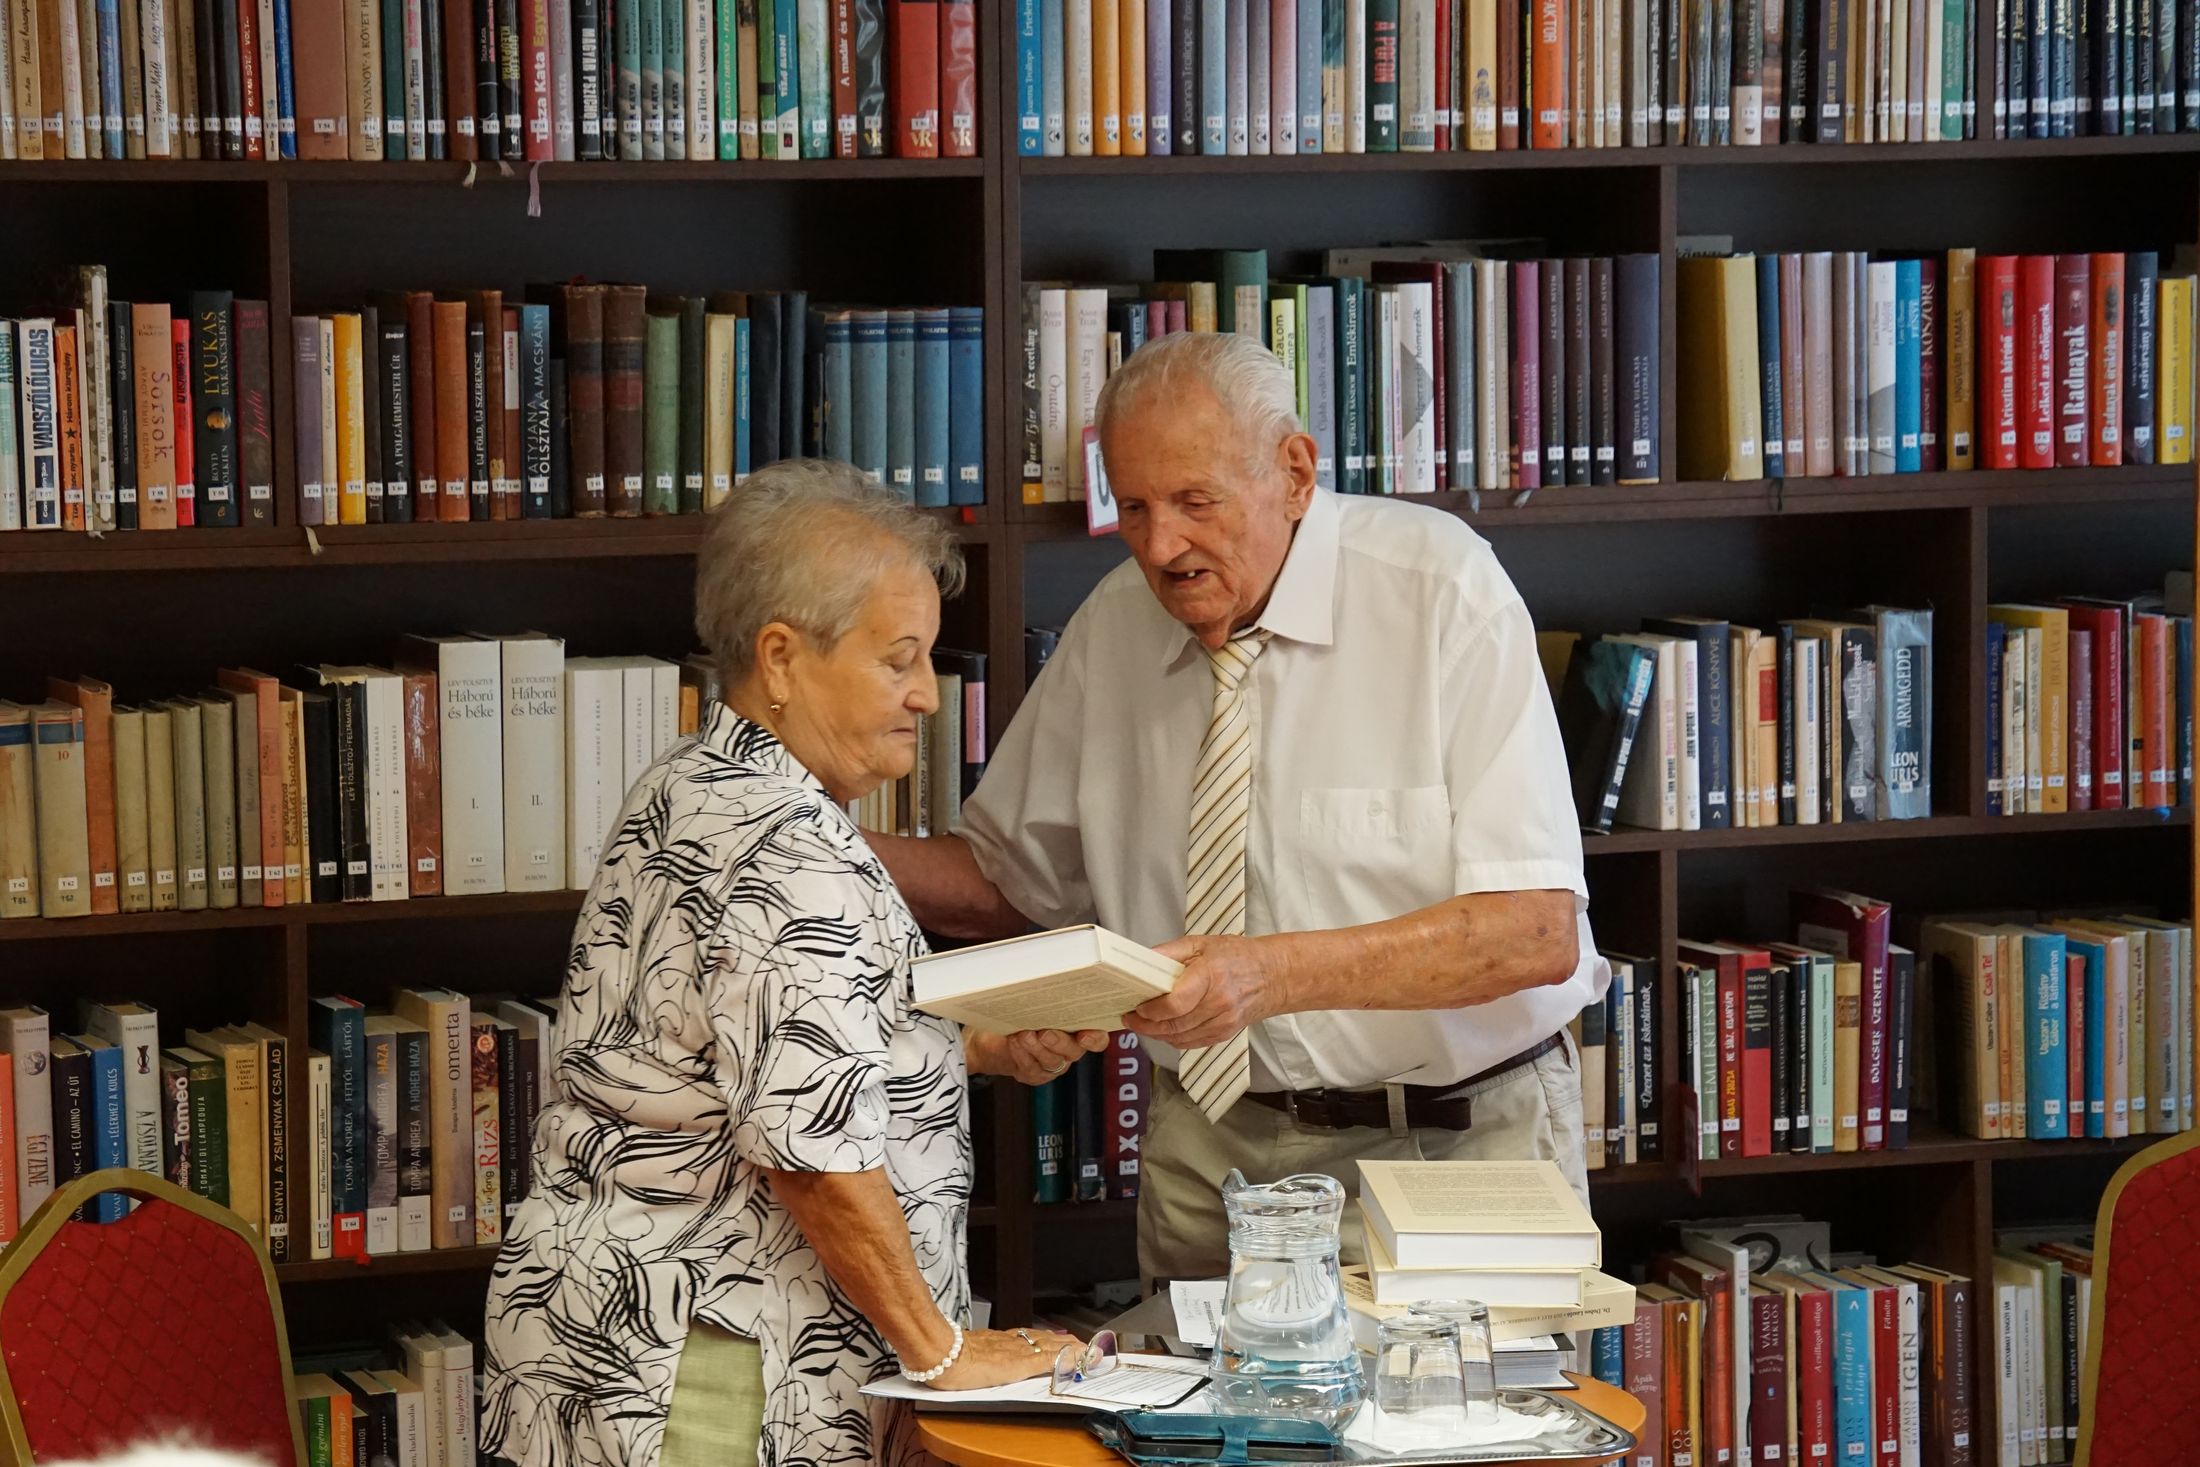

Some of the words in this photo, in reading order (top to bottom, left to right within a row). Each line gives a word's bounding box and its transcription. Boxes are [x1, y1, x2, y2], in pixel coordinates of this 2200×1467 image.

[839, 18, 849, 34] és
[1375, 20, 1395, 30] A
[582, 28, 597, 72] MAGYAR
[839, 43, 850, 73] madár
[1375, 37, 1396, 83] POFON
[536, 52, 549, 93] Kata
[698, 88, 707, 112] Titel
[2138, 277, 2150, 327] koldusai
[1026, 329, 1039, 366] ecetláng
[1345, 292, 1357, 367] Emlékiratok
[2036, 303, 2051, 361] ördögnek
[204, 311, 219, 396] LYUKAS
[218, 310, 228, 395] BAKANCSLISTA
[392, 354, 400, 369] ÚR
[534, 311, 544, 387] MACSKÁNY
[2000, 335, 2013, 373] bárónő
[2139, 330, 2152, 389] szivárvány
[63, 353, 72, 400] kisregény
[474, 351, 482, 408] SZERENCSE
[1026, 369, 1037, 388] Az
[1632, 355, 1640, 400] ULICKAJA
[2039, 364, 2050, 379] az
[2062, 325, 2088, 415] Radnayak
[27, 328, 50, 451] VADSZŐLŐLUGAS
[1048, 373, 1059, 431] Óratánc
[1348, 374, 1357, 409] SÁNDOR
[2000, 375, 2014, 426] Krisztina
[2037, 382, 2051, 423] Lelked
[2141, 391, 2152, 401] A
[393, 374, 403, 454] POLGÁRMESTER
[1026, 408, 1039, 436] Tyler
[475, 423, 484, 450] FÖLD,
[395, 456, 404, 467] A
[448, 688, 494, 703] Háború
[448, 705, 461, 718] és
[465, 703, 494, 719] béke
[511, 686, 557, 701] Háború
[511, 703, 526, 716] és
[529, 701, 557, 716] béke
[1710, 694, 1720, 726] ALICE
[1687, 711, 1696, 736] UPDIKE
[58, 750, 70, 760] 10
[285, 710, 299, 787] boldogság
[286, 786, 298, 847] Családi
[531, 794, 543, 807] II.
[1984, 973, 1994, 996] Csak
[2037, 974, 2049, 1010] Kislány
[2049, 950, 2060, 1001] láthatáron
[1872, 967, 1883, 1024] ÜZENETE
[445, 1012, 460, 1081] omerta
[2039, 1018, 2049, 1056] Vaszary
[2049, 1018, 2059, 1046] Gábor
[375, 1043, 388, 1074] HAZA
[1644, 1046, 1653, 1062] az
[1871, 1031, 1881, 1085] BÖLCSEK
[70, 1075, 80, 1087] ÚT
[108, 1068, 117, 1092] KULCS
[272, 1048, 283, 1098] CSALÁD
[1638, 1062, 1653, 1109] Üzenet
[71, 1088, 80, 1097] AZ
[376, 1082, 389, 1124] ANDREA
[71, 1108, 81, 1140] CAMINO
[109, 1102, 118, 1138] LÉLEKHEZ
[136, 1109, 149, 1119] A
[174, 1077, 189, 1146] Tomeo
[26, 1135, 50, 1155] ÉGI
[71, 1141, 82, 1150] EL
[273, 1100, 285, 1161] ZSMENYAK
[343, 1112, 353, 1155] ANDREA
[376, 1127, 388, 1166] TOMPA
[410, 1119, 421, 1158] ANDREA
[478, 1118, 499, 1168] Rizs
[1038, 1135, 1063, 1148] LEON
[278, 1165, 286, 1174] A
[1038, 1147, 1063, 1160] URIS
[28, 1157, 49, 1188] ZENE
[344, 1157, 353, 1193] TOMPA
[410, 1160, 421, 1191] TOMPA
[483, 1170, 497, 1194] Tong
[1583, 1308, 1602, 1316] Dobos
[1762, 1303, 1770, 1349] VÁMOS
[1813, 1302, 1822, 1326] világa
[1634, 1315, 1642, 1360] VÁMOS
[1643, 1316, 1651, 1360] MIKLÓS
[1813, 1328, 1823, 1364] csillagok
[1815, 1364, 1822, 1372] A
[1842, 1330, 1855, 1389] csillagok
[1902, 1332, 1918, 1391] IGEN
[1955, 1360, 1964, 1387] isten
[1630, 1383, 1658, 1394] könyve
[1633, 1374, 1654, 1385] Apák
[1854, 1363, 1866, 1406] világa
[456, 1376, 465, 1434] Nagylánykönyv
[1843, 1396, 1854, 1406] A
[358, 1428, 367, 1444] TÓTH
